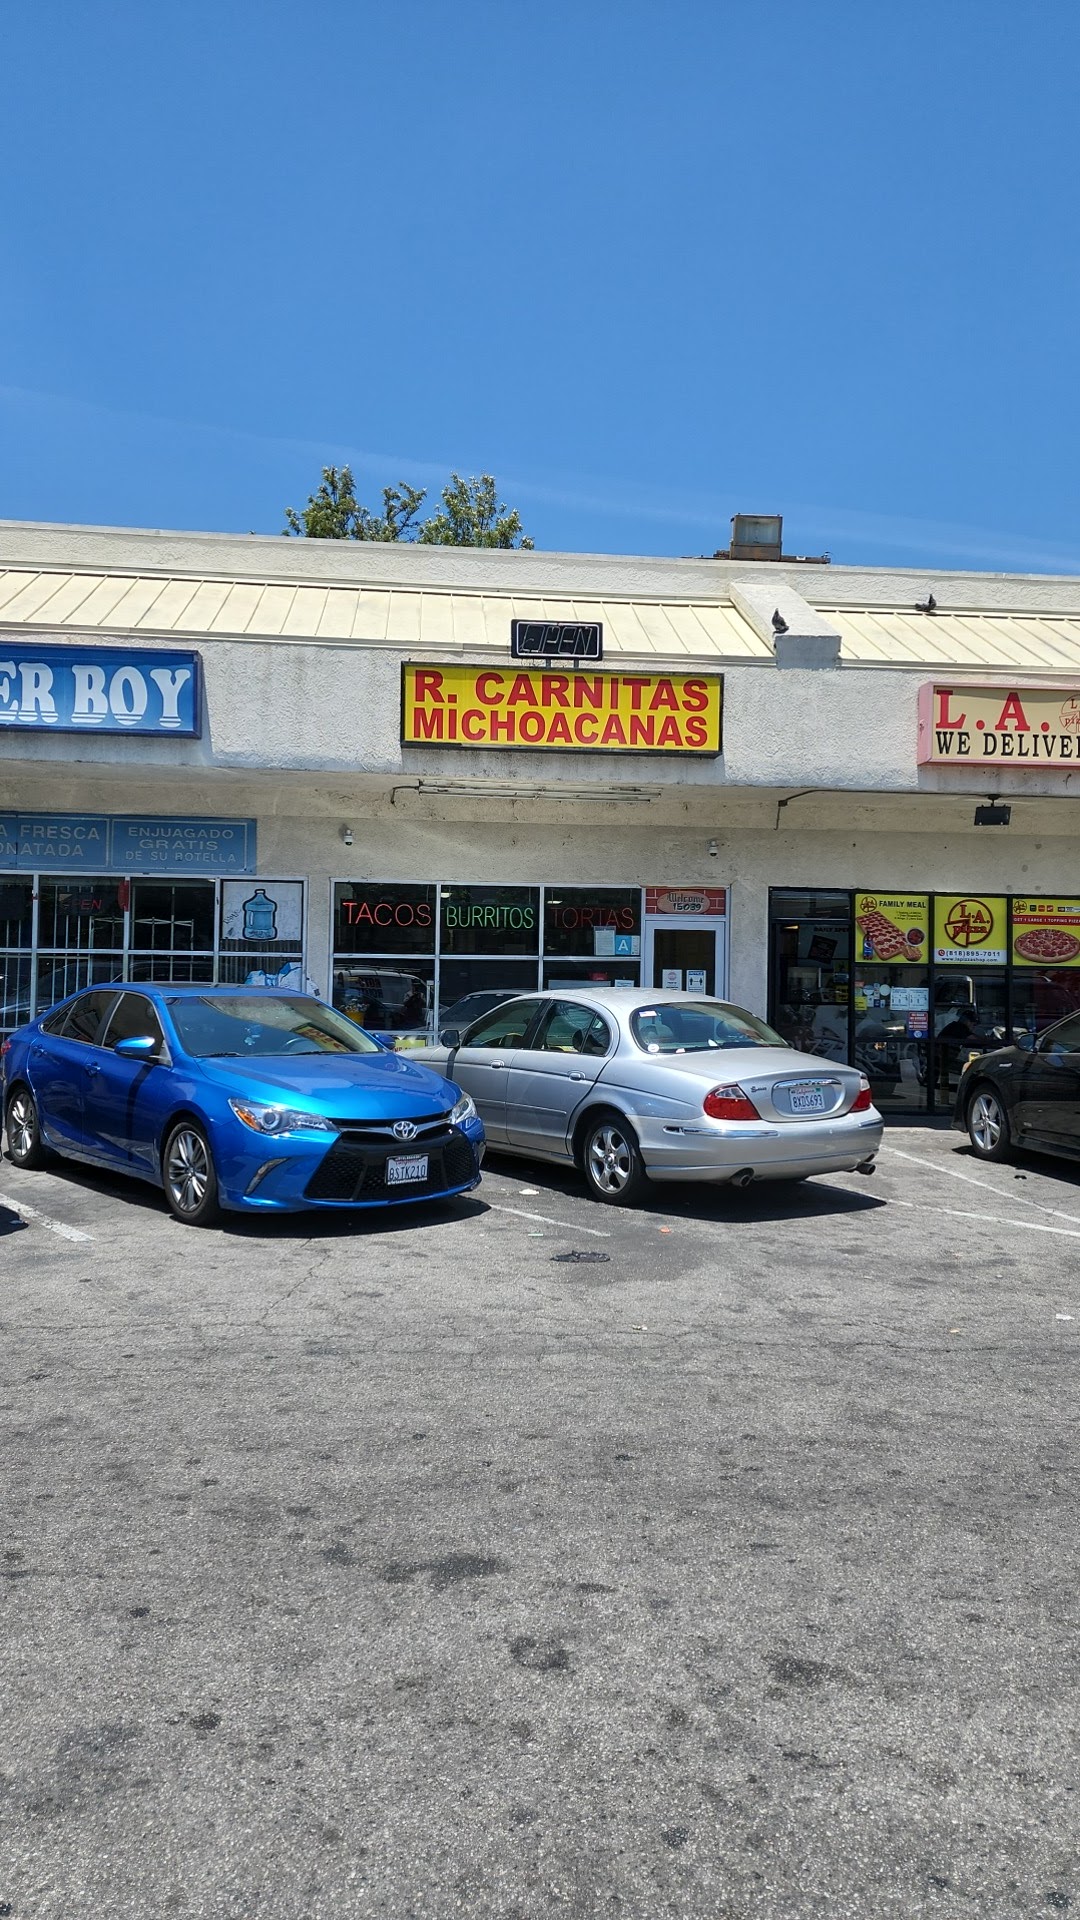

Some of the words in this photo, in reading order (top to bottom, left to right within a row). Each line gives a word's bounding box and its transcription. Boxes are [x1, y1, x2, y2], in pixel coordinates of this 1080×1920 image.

[520, 625, 593, 656] OPEN
[71, 665, 191, 728] BOY
[414, 670, 457, 704] R.
[475, 672, 709, 712] CARNITAS
[413, 707, 708, 747] MICHOACANAS
[936, 731, 971, 756] WE
[983, 733, 1080, 758] DELIVE
[20, 825, 100, 840] FRESCA
[128, 827, 234, 839] ENJUAGADO
[139, 839, 218, 851] GRATIS
[125, 851, 142, 860] DE
[150, 852, 168, 861] SU
[175, 853, 236, 863] BOTELLA
[342, 902, 432, 926] TACOS
[879, 900, 905, 908] FAMILY
[446, 905, 534, 928] BURRITOS
[550, 907, 634, 929] TORTAS
[618, 939, 629, 951] A
